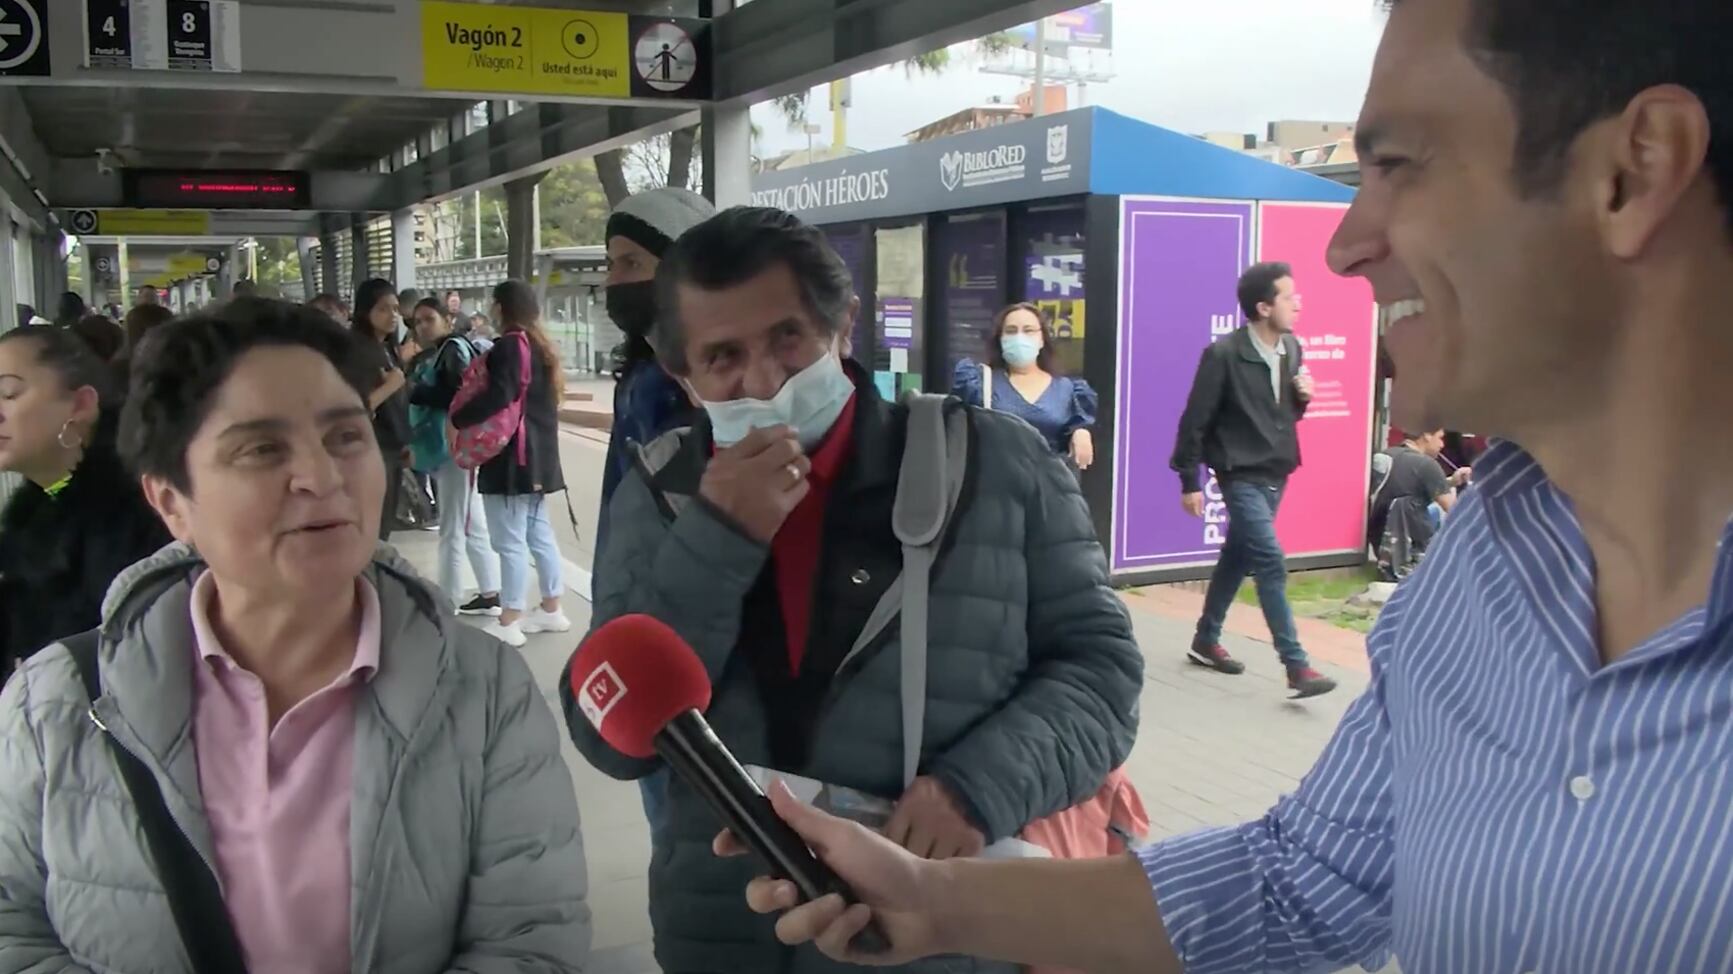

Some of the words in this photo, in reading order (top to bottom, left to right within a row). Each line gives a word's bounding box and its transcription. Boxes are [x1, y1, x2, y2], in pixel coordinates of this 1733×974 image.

[102, 15, 117, 37] 4
[182, 11, 196, 33] 8
[446, 22, 507, 51] Vagón
[511, 27, 523, 48] 2
[515, 55, 524, 70] 2
[542, 62, 571, 75] Usted
[573, 64, 593, 77] está
[825, 169, 889, 206] HÉROES
